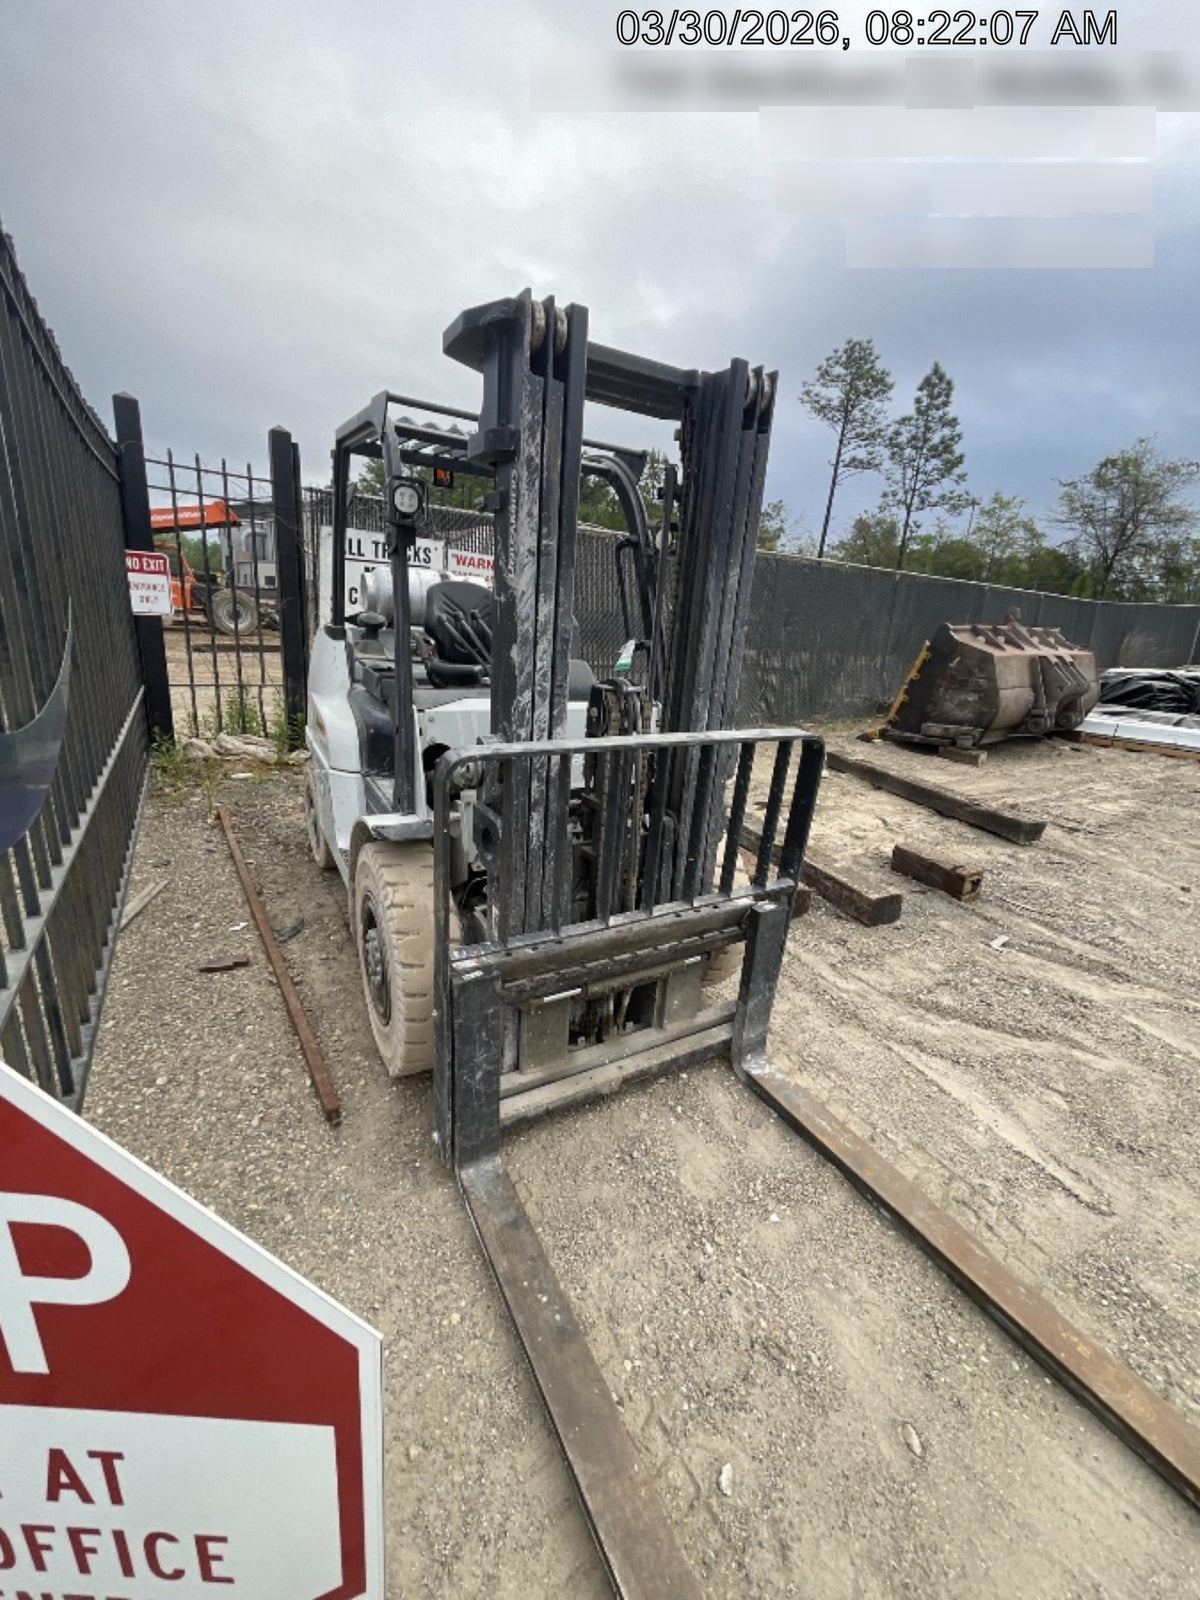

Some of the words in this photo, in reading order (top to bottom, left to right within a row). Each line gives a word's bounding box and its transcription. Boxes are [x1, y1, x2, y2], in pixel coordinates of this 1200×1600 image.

[143, 557, 165, 572] EXIT
[346, 538, 366, 557] LL
[371, 540, 431, 565] TRCKS
[46, 1447, 125, 1506] AT
